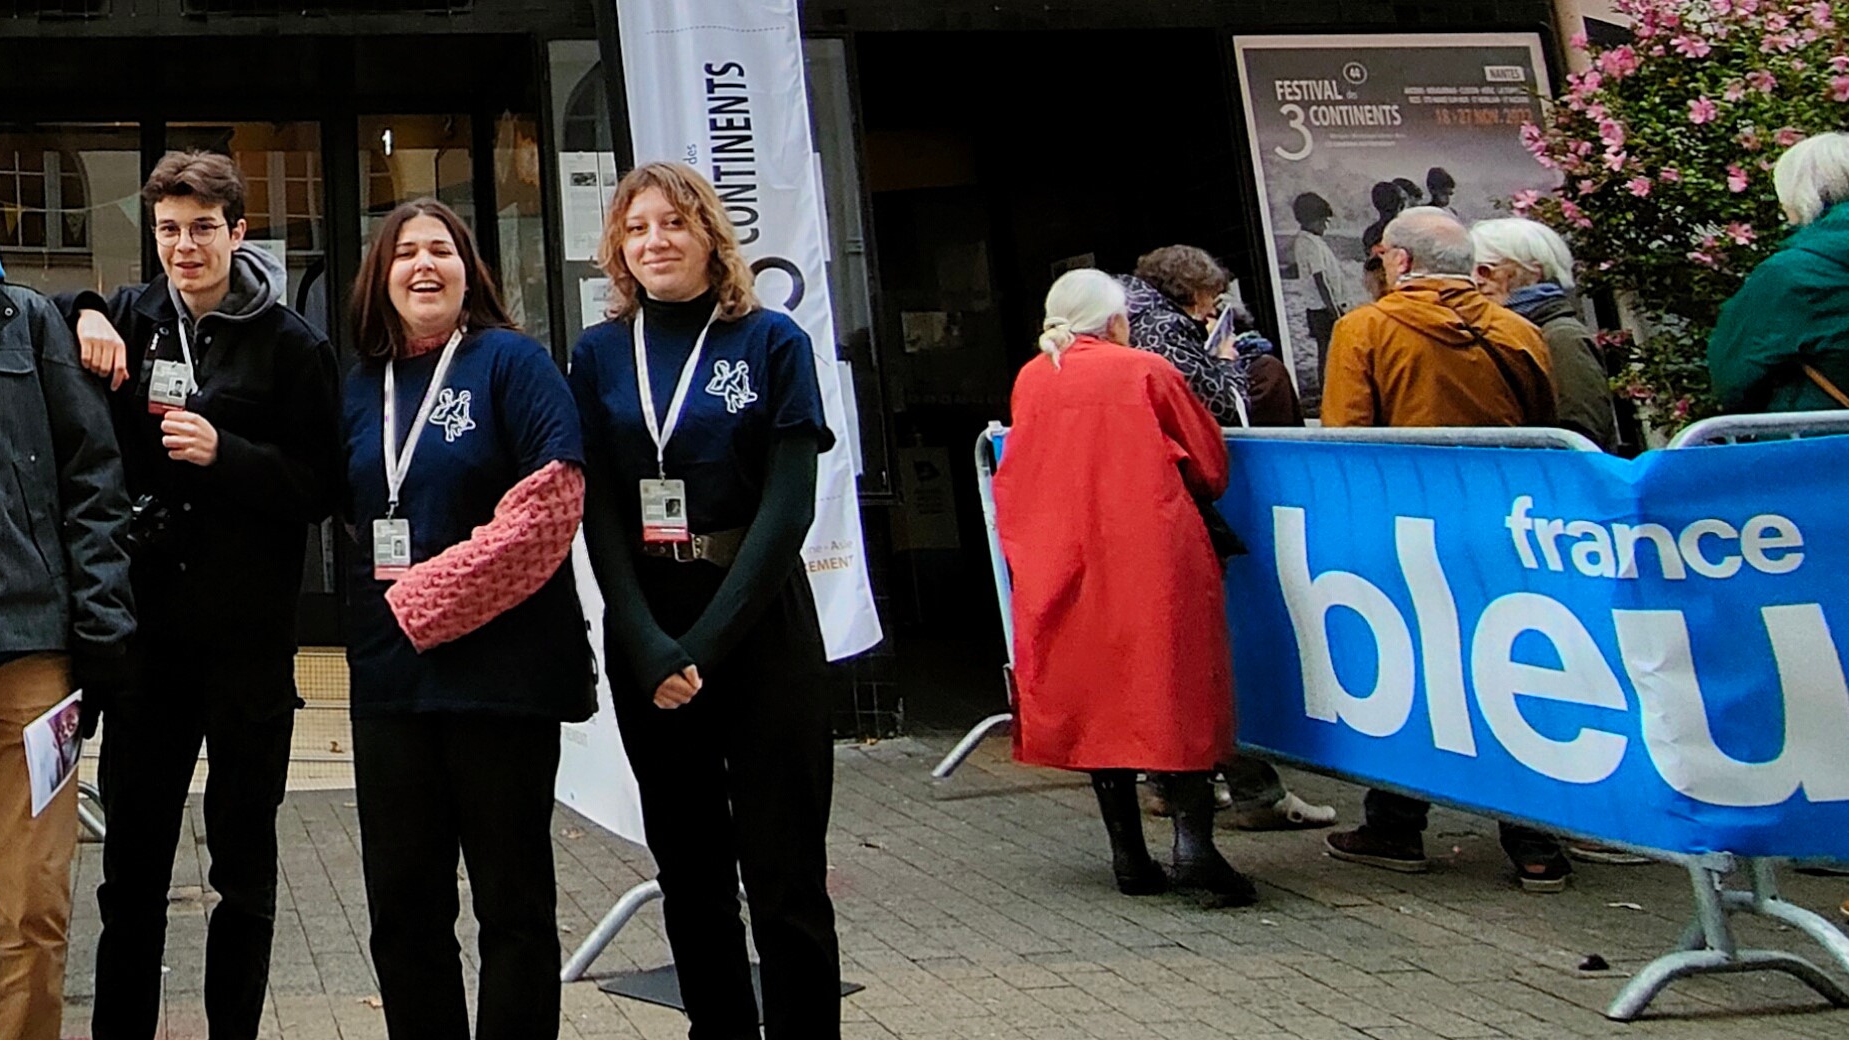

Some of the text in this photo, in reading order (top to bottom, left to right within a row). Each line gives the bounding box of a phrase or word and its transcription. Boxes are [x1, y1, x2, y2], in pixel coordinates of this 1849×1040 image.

[1274, 79, 1343, 101] FESTIVAL
[1489, 68, 1520, 79] NANTES
[1274, 103, 1402, 160] 3 CONTINENTS
[683, 143, 697, 165] des
[1506, 495, 1806, 580] france
[1272, 505, 1849, 807] bleu
